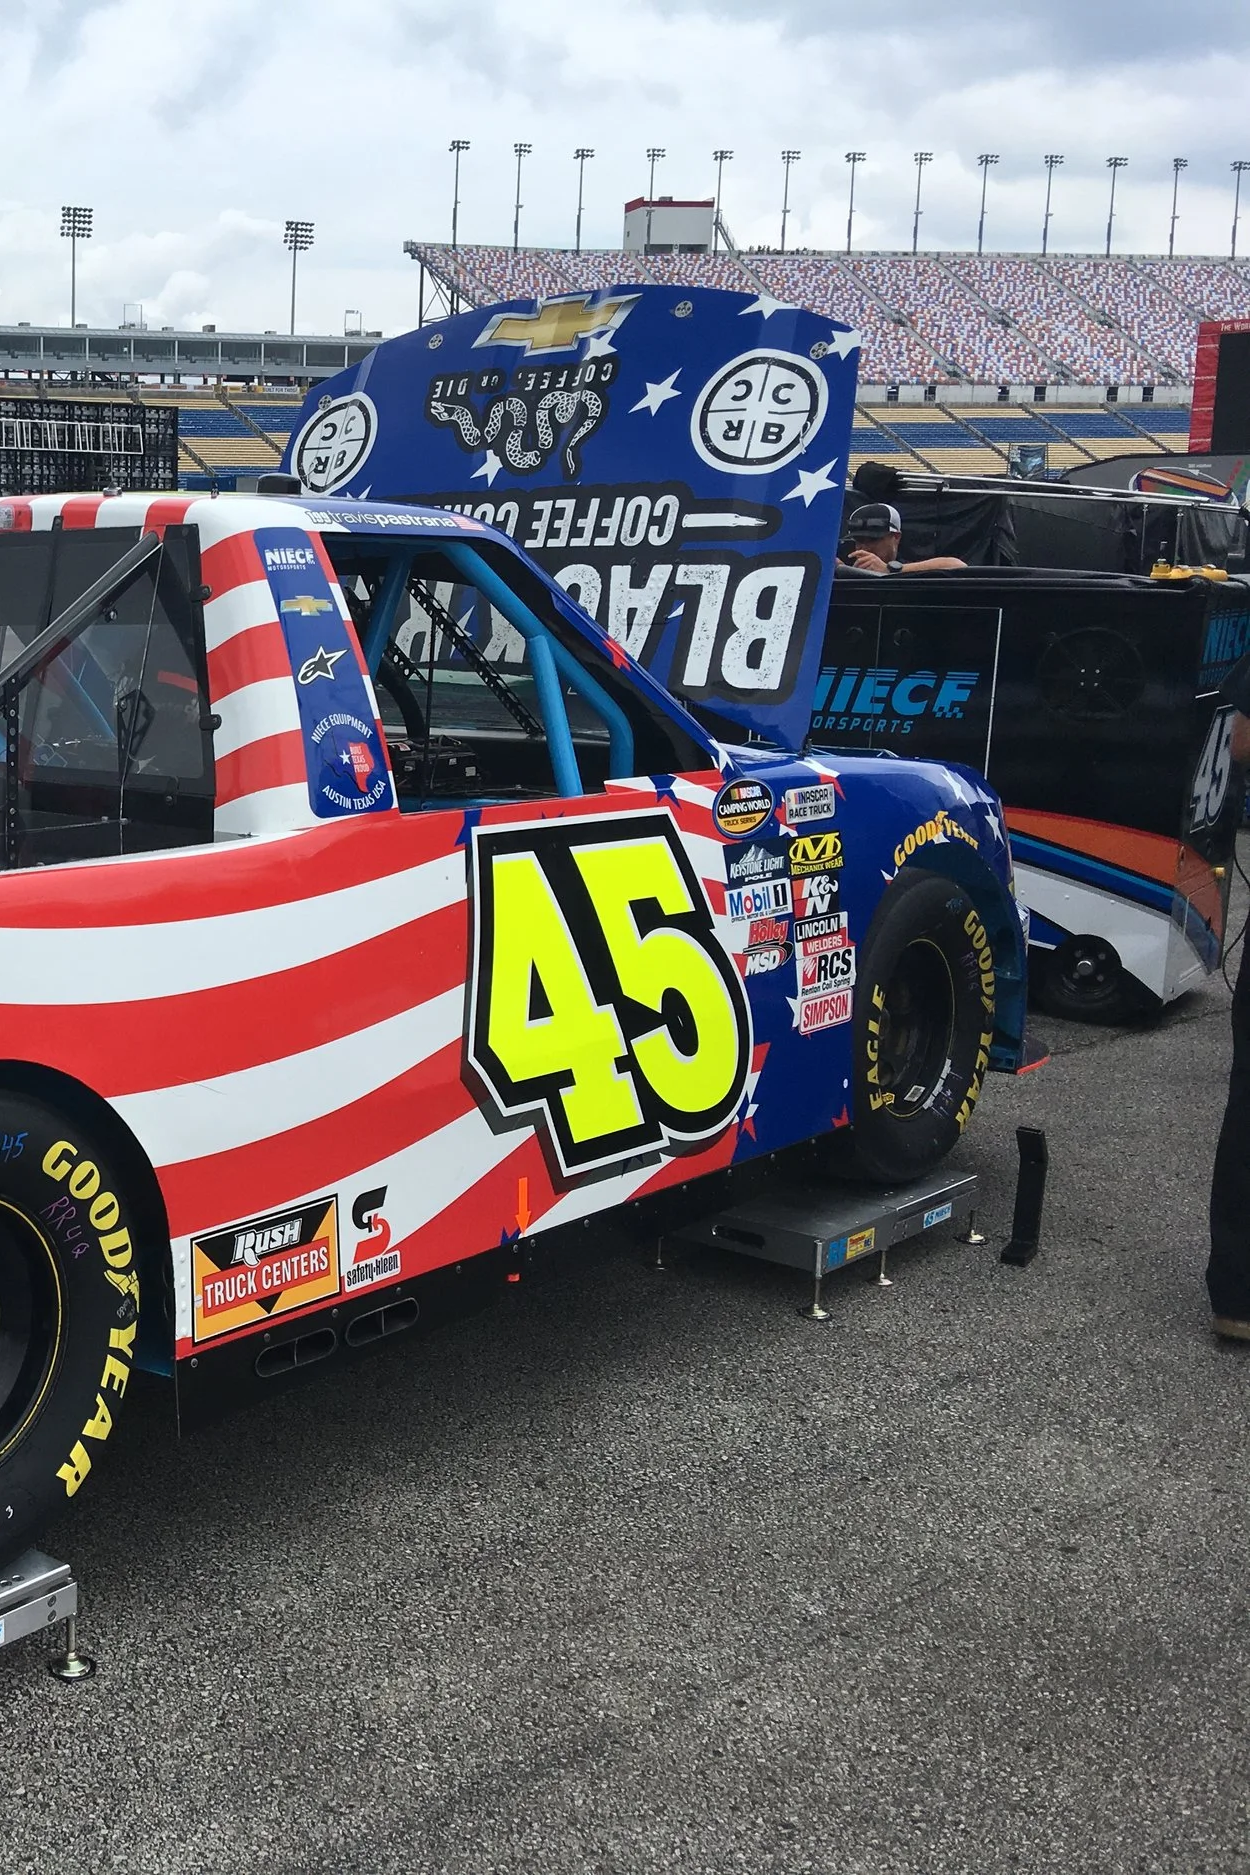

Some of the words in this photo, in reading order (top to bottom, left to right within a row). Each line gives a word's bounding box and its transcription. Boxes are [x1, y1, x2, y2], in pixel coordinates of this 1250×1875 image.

[432, 378, 469, 398] DIE
[524, 495, 679, 548] COFFEE
[264, 548, 315, 565] NIECE
[311, 717, 330, 744] NIECE
[329, 714, 374, 739] EQUIPMENT
[812, 716, 914, 734] ORSPORTS
[322, 785, 352, 810] AUSTIN
[353, 793, 375, 810] TEXAS
[372, 780, 387, 799] USA
[738, 786, 762, 799] NASCAR
[799, 788, 829, 803] NASCAR
[719, 802, 748, 815] CAMPING
[747, 799, 771, 811] WORLD
[789, 806, 808, 818] RACE
[809, 804, 831, 815] TRUCK
[723, 817, 739, 826] TRUCK
[739, 816, 756, 825] SERIES
[730, 861, 764, 878] KEYSTONE
[764, 856, 784, 871] LIGHT
[791, 861, 825, 876] MECHANIX
[825, 856, 843, 870] WEAR
[745, 873, 772, 882] POLE
[728, 886, 771, 917] Mobil
[749, 919, 788, 945] Holley
[796, 917, 838, 940] LINCOLN
[807, 935, 842, 954] WELDERS
[745, 950, 780, 976] MSD
[817, 949, 853, 983] RCS
[488, 836, 740, 1144] 45
[801, 985, 821, 997] Renton
[822, 981, 833, 991] Coil
[834, 977, 851, 989] Spring
[803, 993, 849, 1029] SIMPSON
[204, 1270, 257, 1309] TRUCK
[262, 1246, 329, 1289] CENTERS
